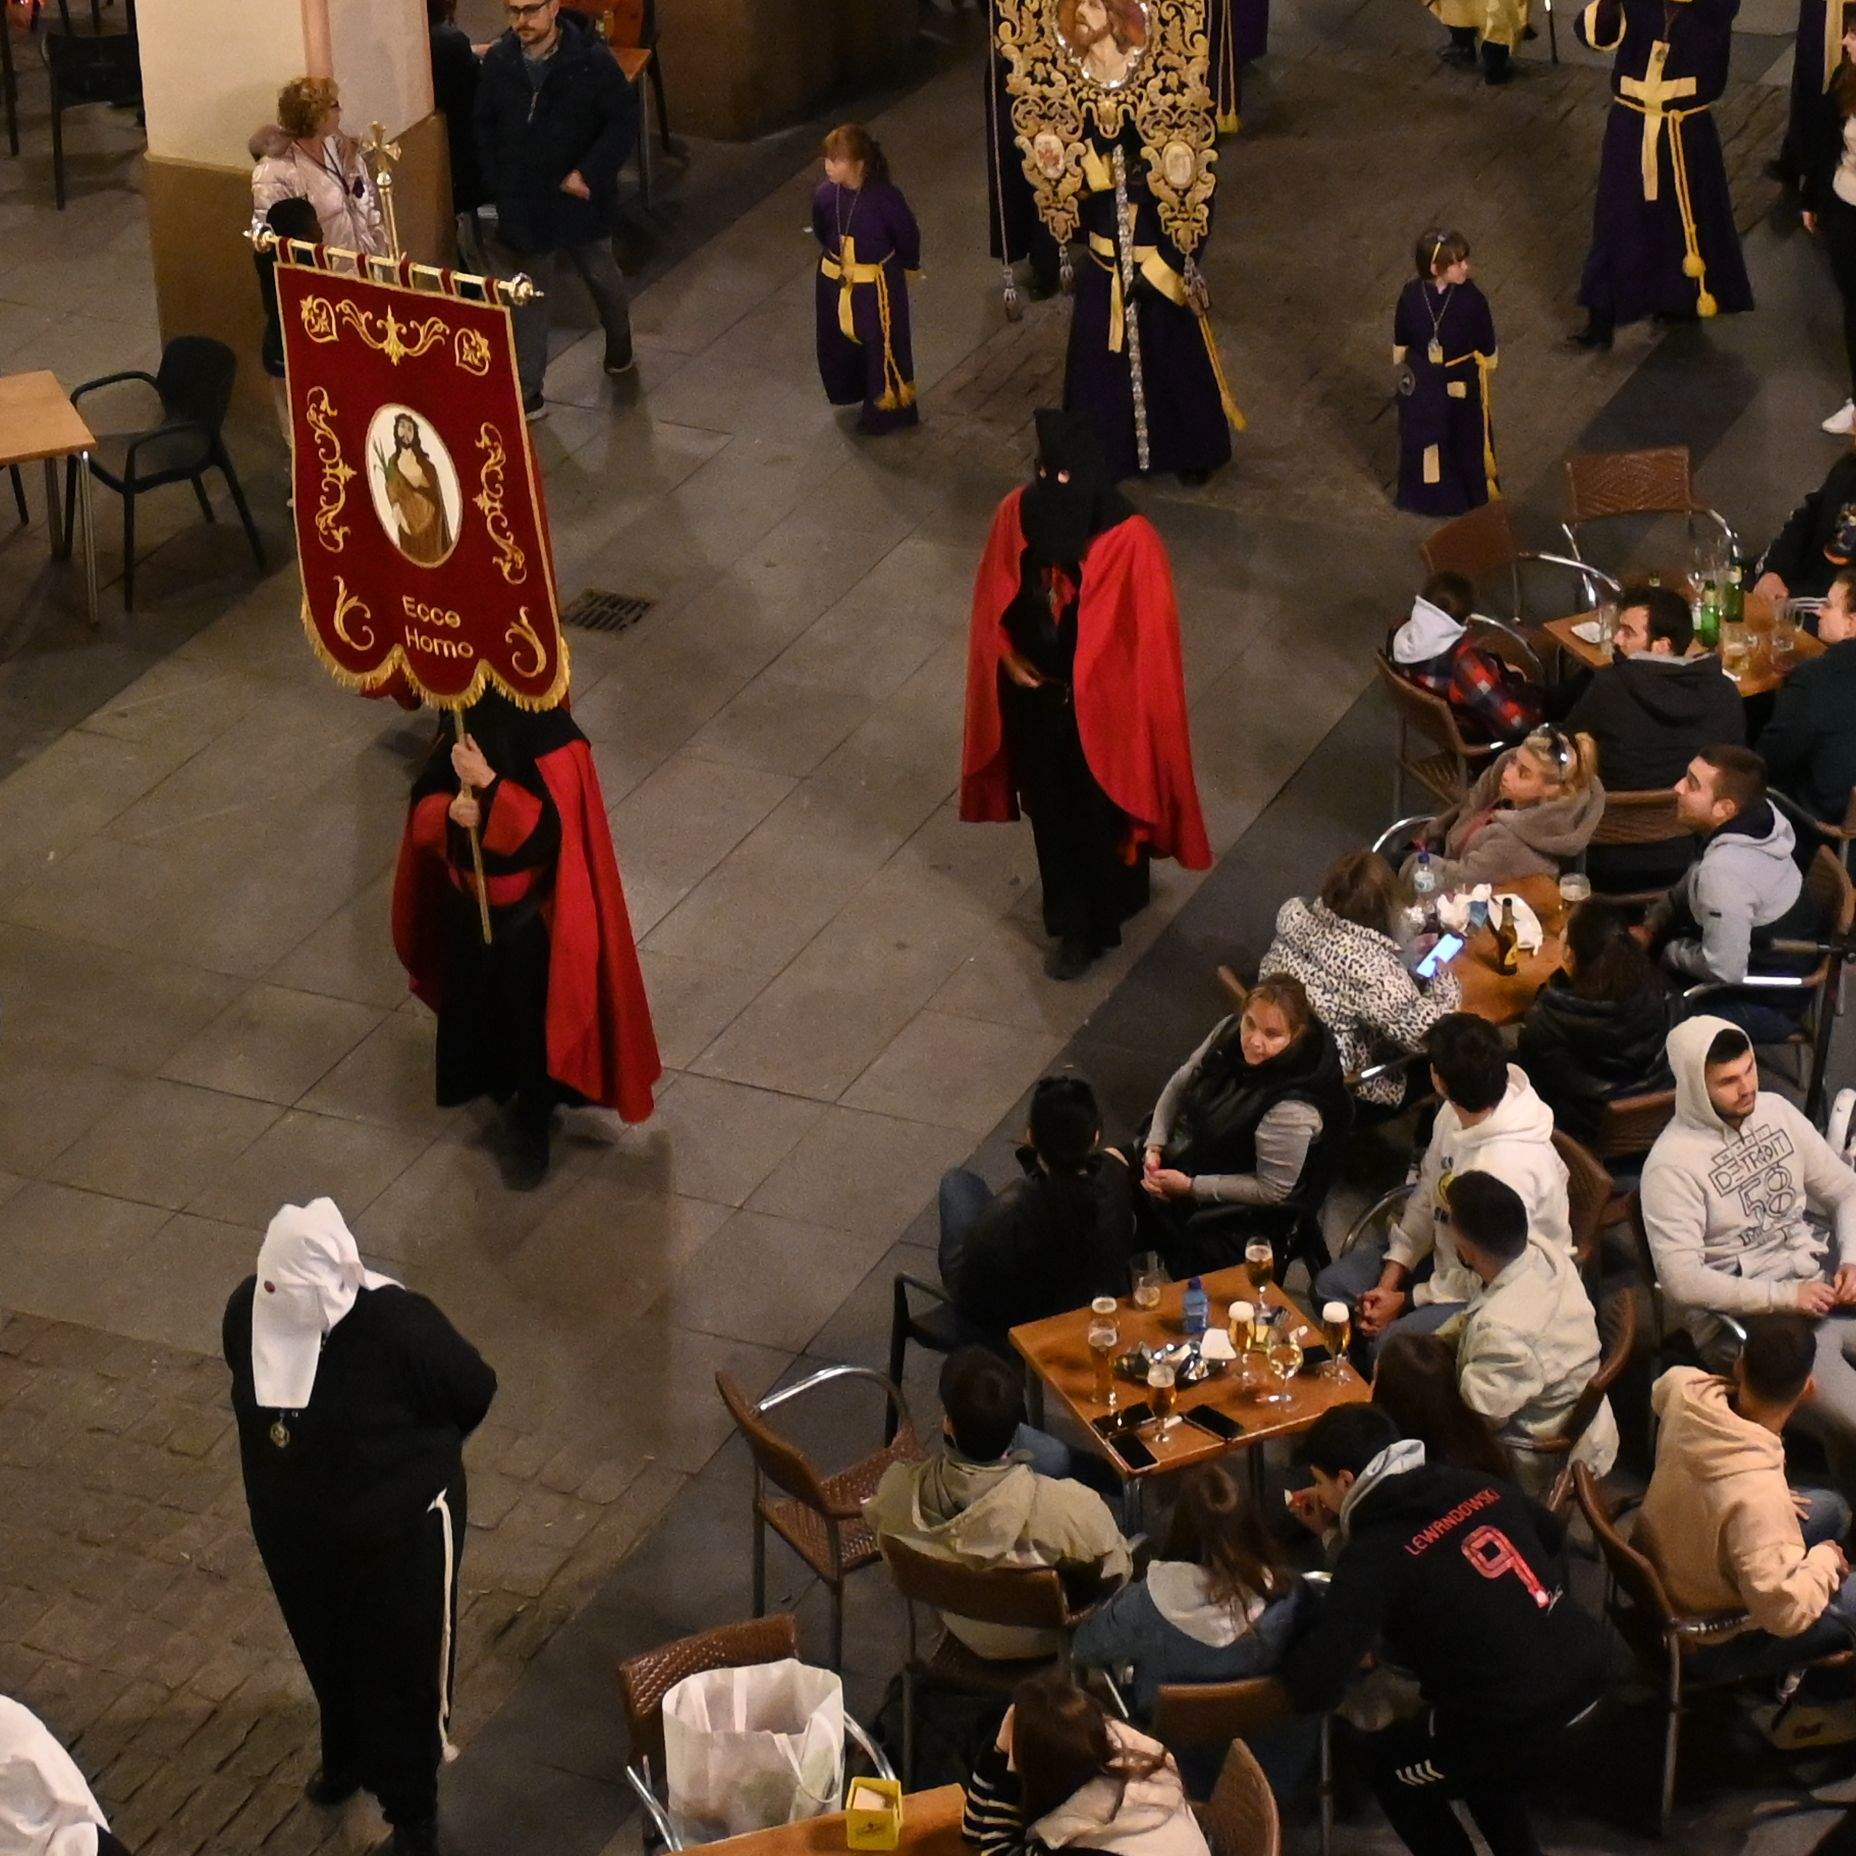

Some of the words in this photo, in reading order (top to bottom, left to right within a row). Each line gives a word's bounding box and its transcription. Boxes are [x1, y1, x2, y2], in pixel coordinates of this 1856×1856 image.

[405, 625, 474, 659] Homo
[1715, 1134, 1786, 1190] DETROIT
[1460, 1524, 1549, 1609] 9
